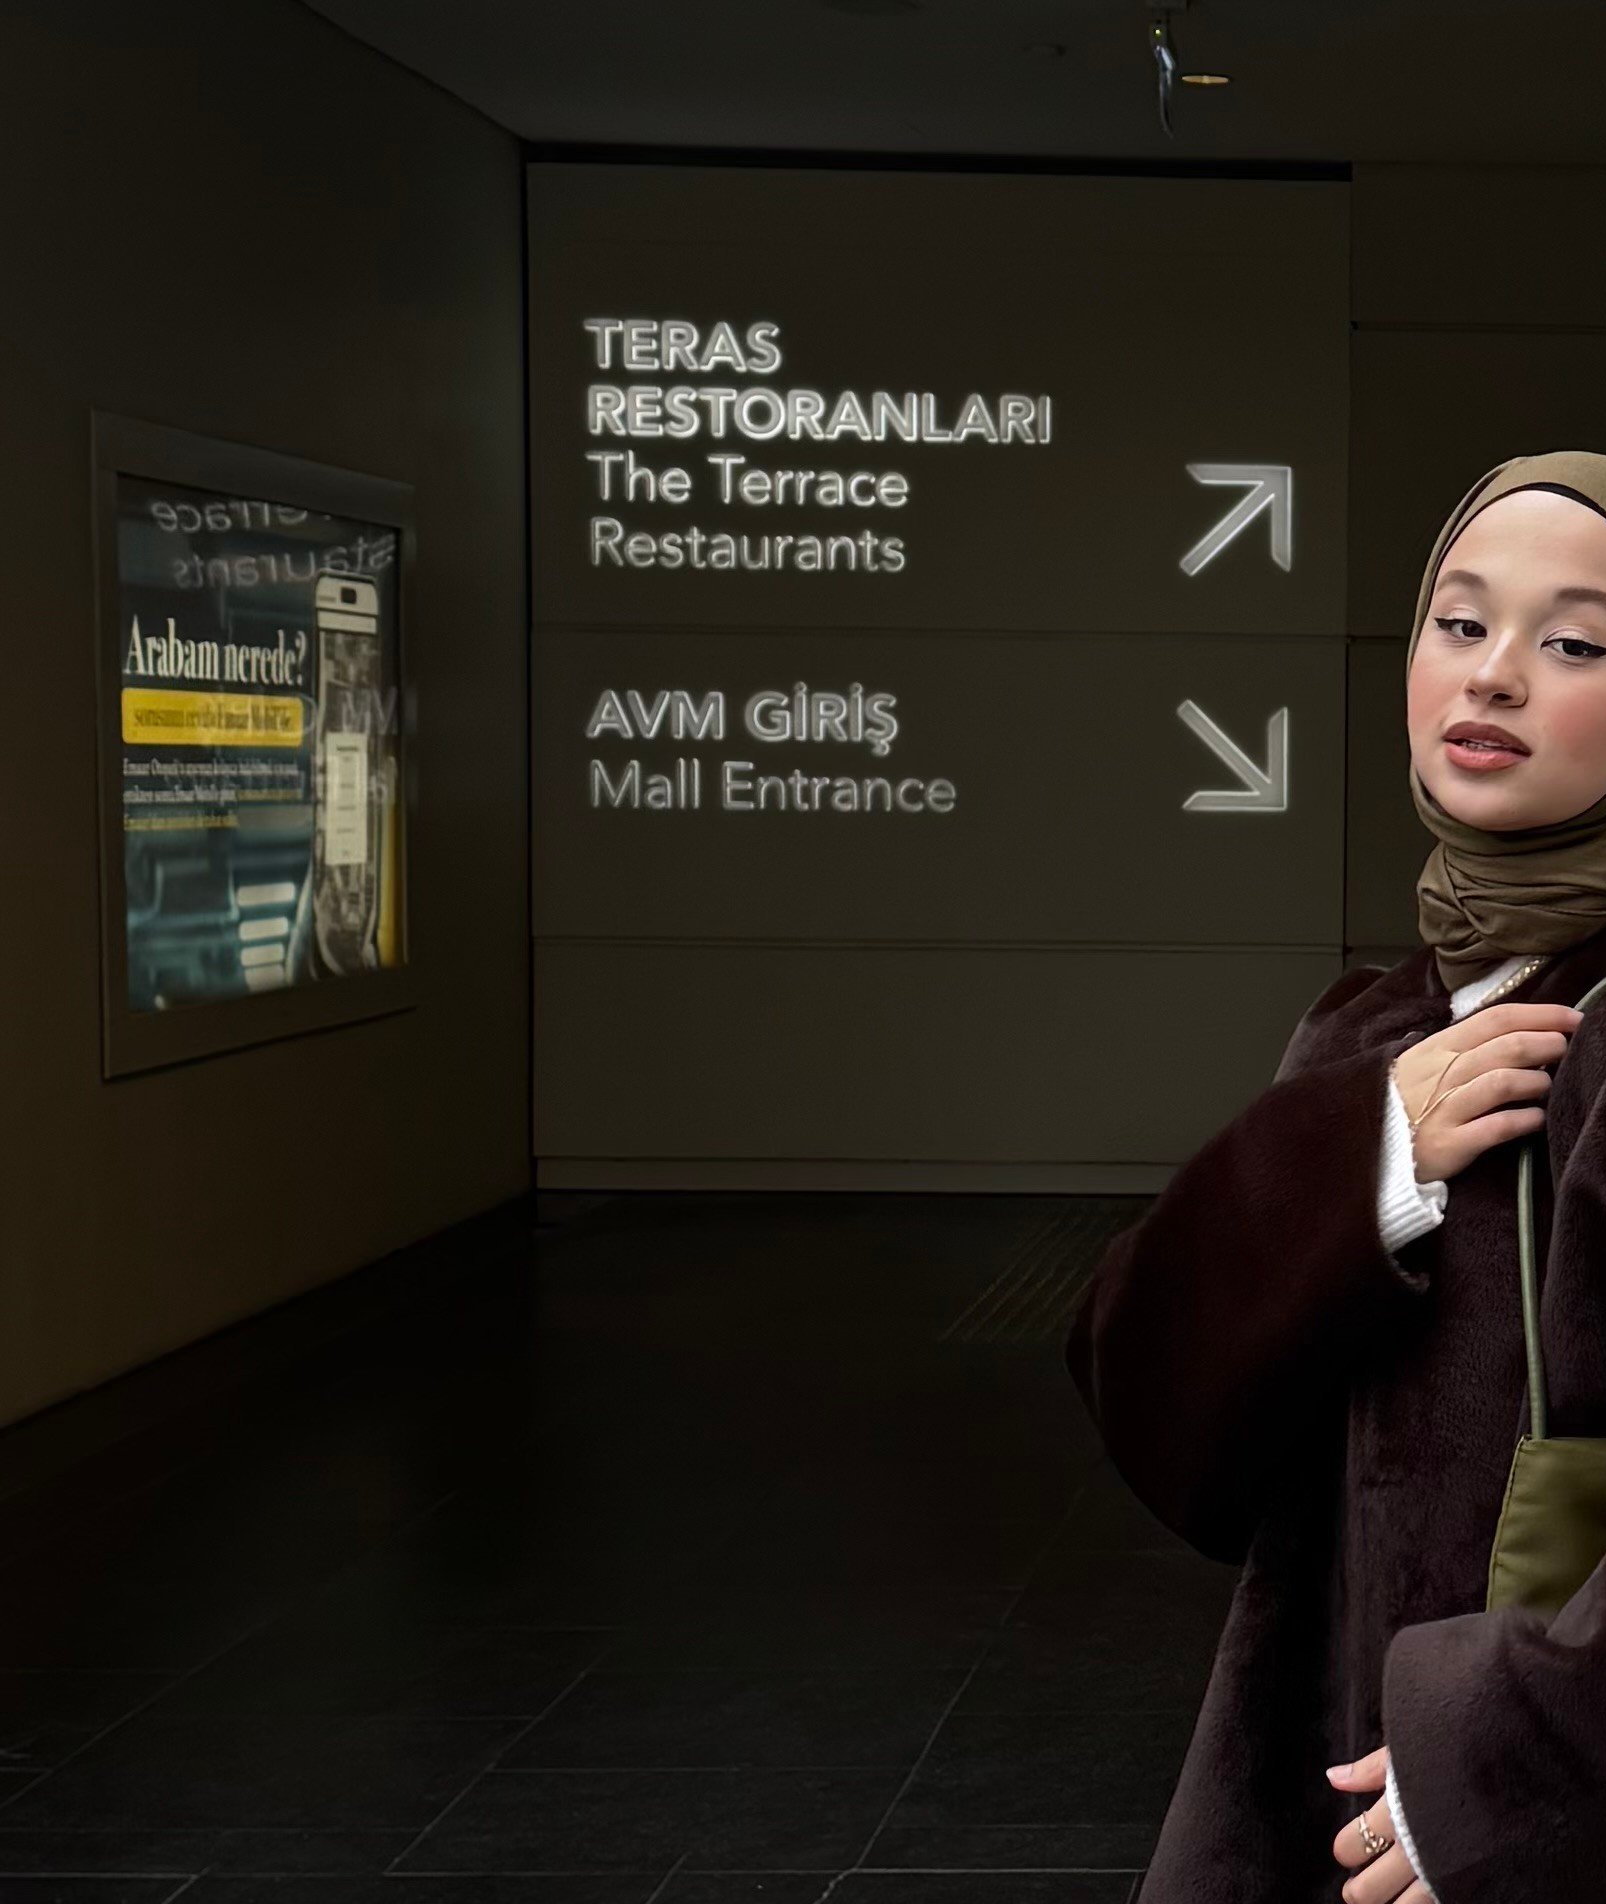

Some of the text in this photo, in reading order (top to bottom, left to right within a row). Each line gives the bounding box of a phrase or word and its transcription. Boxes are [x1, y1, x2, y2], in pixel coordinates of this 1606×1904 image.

[584, 318, 782, 374] TERAS
[587, 384, 1052, 444] RESTORANLARI
[585, 449, 910, 508] The Terrace
[590, 516, 906, 573] Restaurants
[121, 614, 308, 686] Arabam nerede?
[587, 682, 899, 756] AVM GİRİŞ
[591, 757, 956, 813] Mall Entrance
